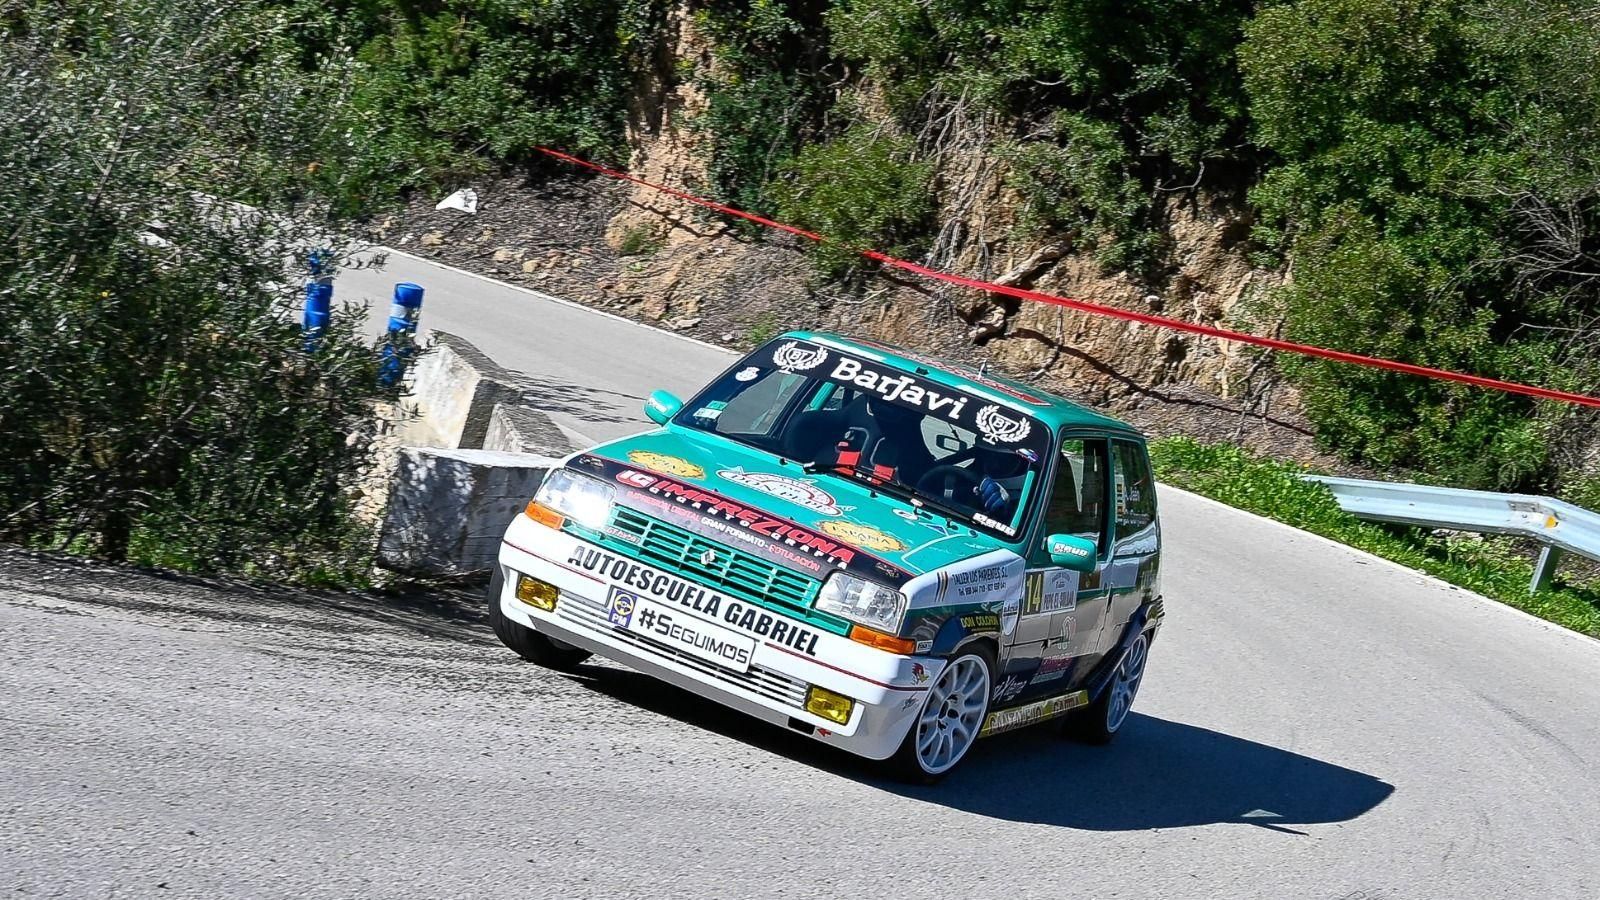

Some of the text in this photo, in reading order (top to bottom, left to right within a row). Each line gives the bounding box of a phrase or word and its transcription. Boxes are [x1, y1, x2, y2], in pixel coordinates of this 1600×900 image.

[830, 357, 968, 420] BarJavi
[655, 480, 855, 563] IMPREZIONA
[701, 517, 726, 532] GRAN
[725, 525, 766, 547] FORMATO
[568, 545, 820, 657] AUTOESCUELA GABRIEL
[1026, 573, 1042, 613] 14
